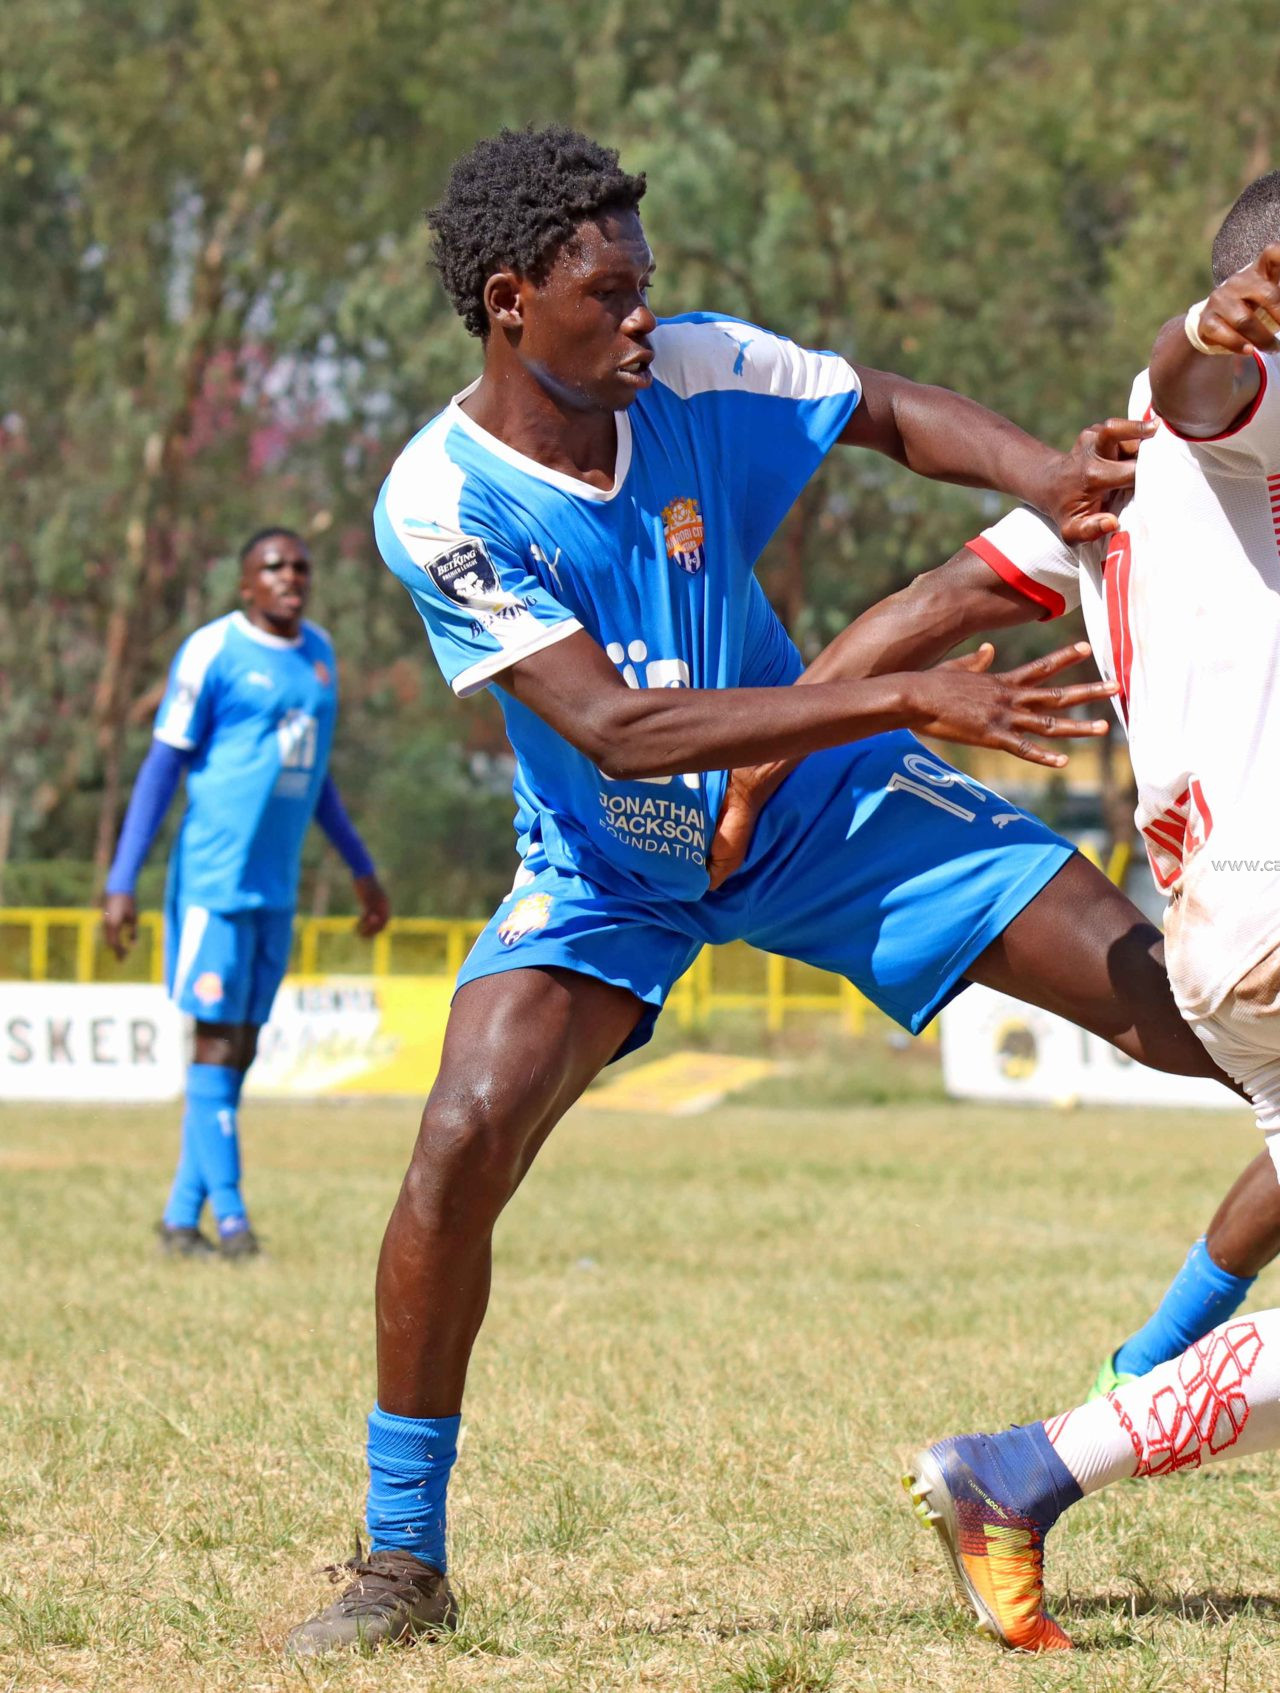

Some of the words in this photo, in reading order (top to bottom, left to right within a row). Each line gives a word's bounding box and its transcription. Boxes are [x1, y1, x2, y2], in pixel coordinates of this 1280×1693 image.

[885, 754, 986, 823] 19
[600, 818, 706, 865] FOUNDATIO
[606, 810, 705, 850] JACKSON
